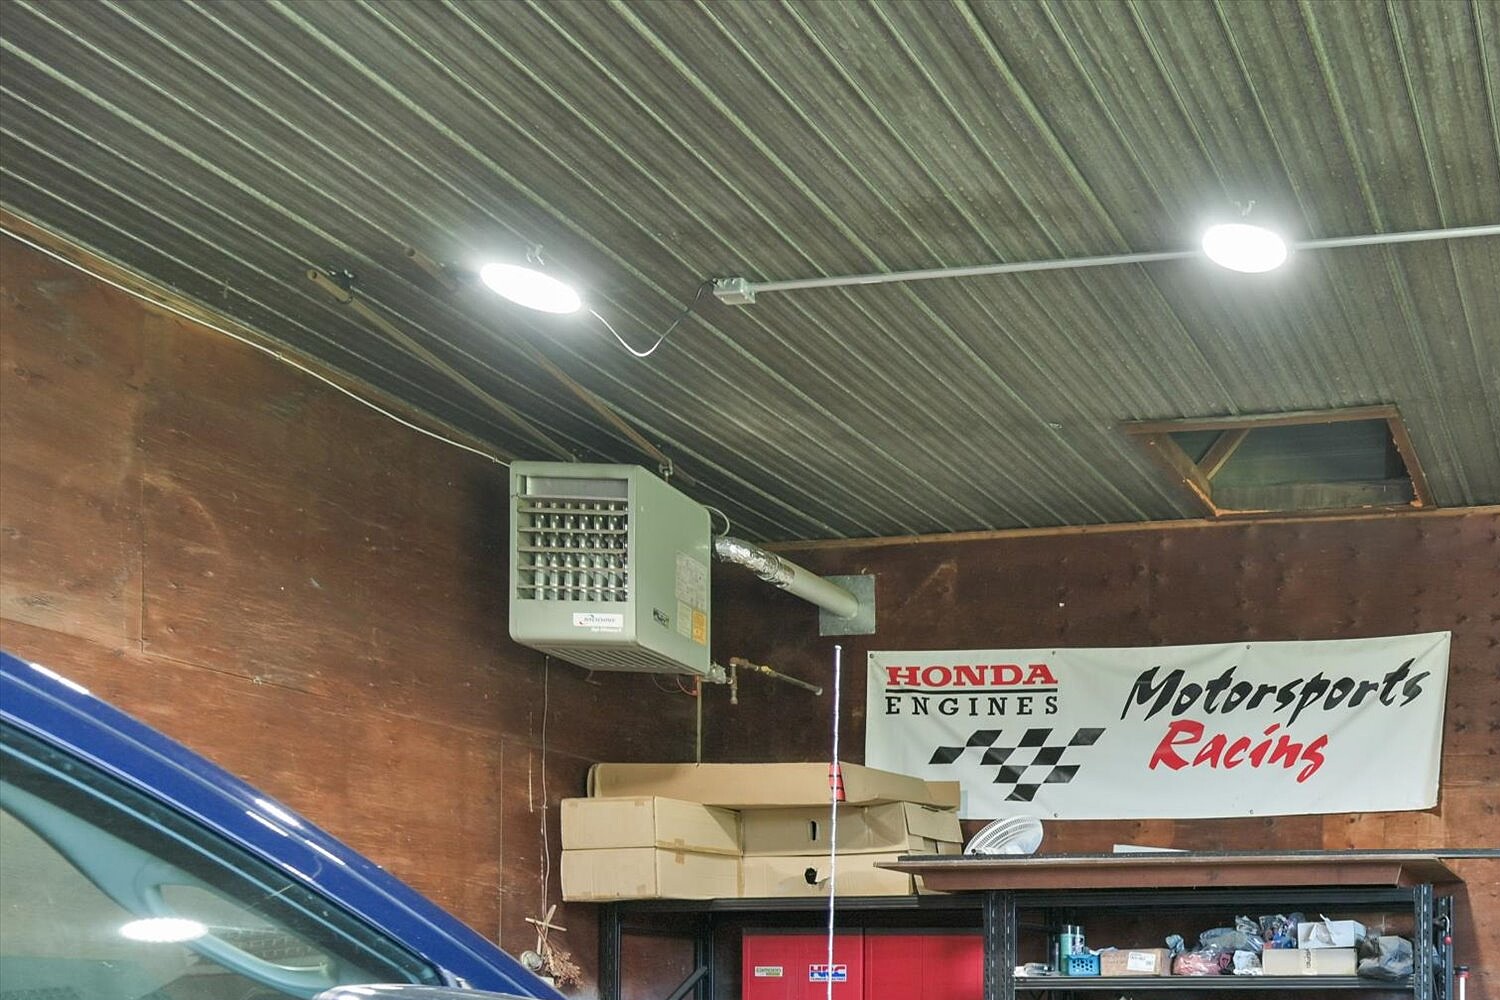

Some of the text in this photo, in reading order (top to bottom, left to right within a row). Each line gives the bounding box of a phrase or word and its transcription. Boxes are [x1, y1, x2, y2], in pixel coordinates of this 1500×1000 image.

[885, 663, 1058, 687] HONDA
[1121, 657, 1432, 727] Motorsports
[885, 696, 1059, 716] ENGINES
[1149, 720, 1329, 783] Racing
